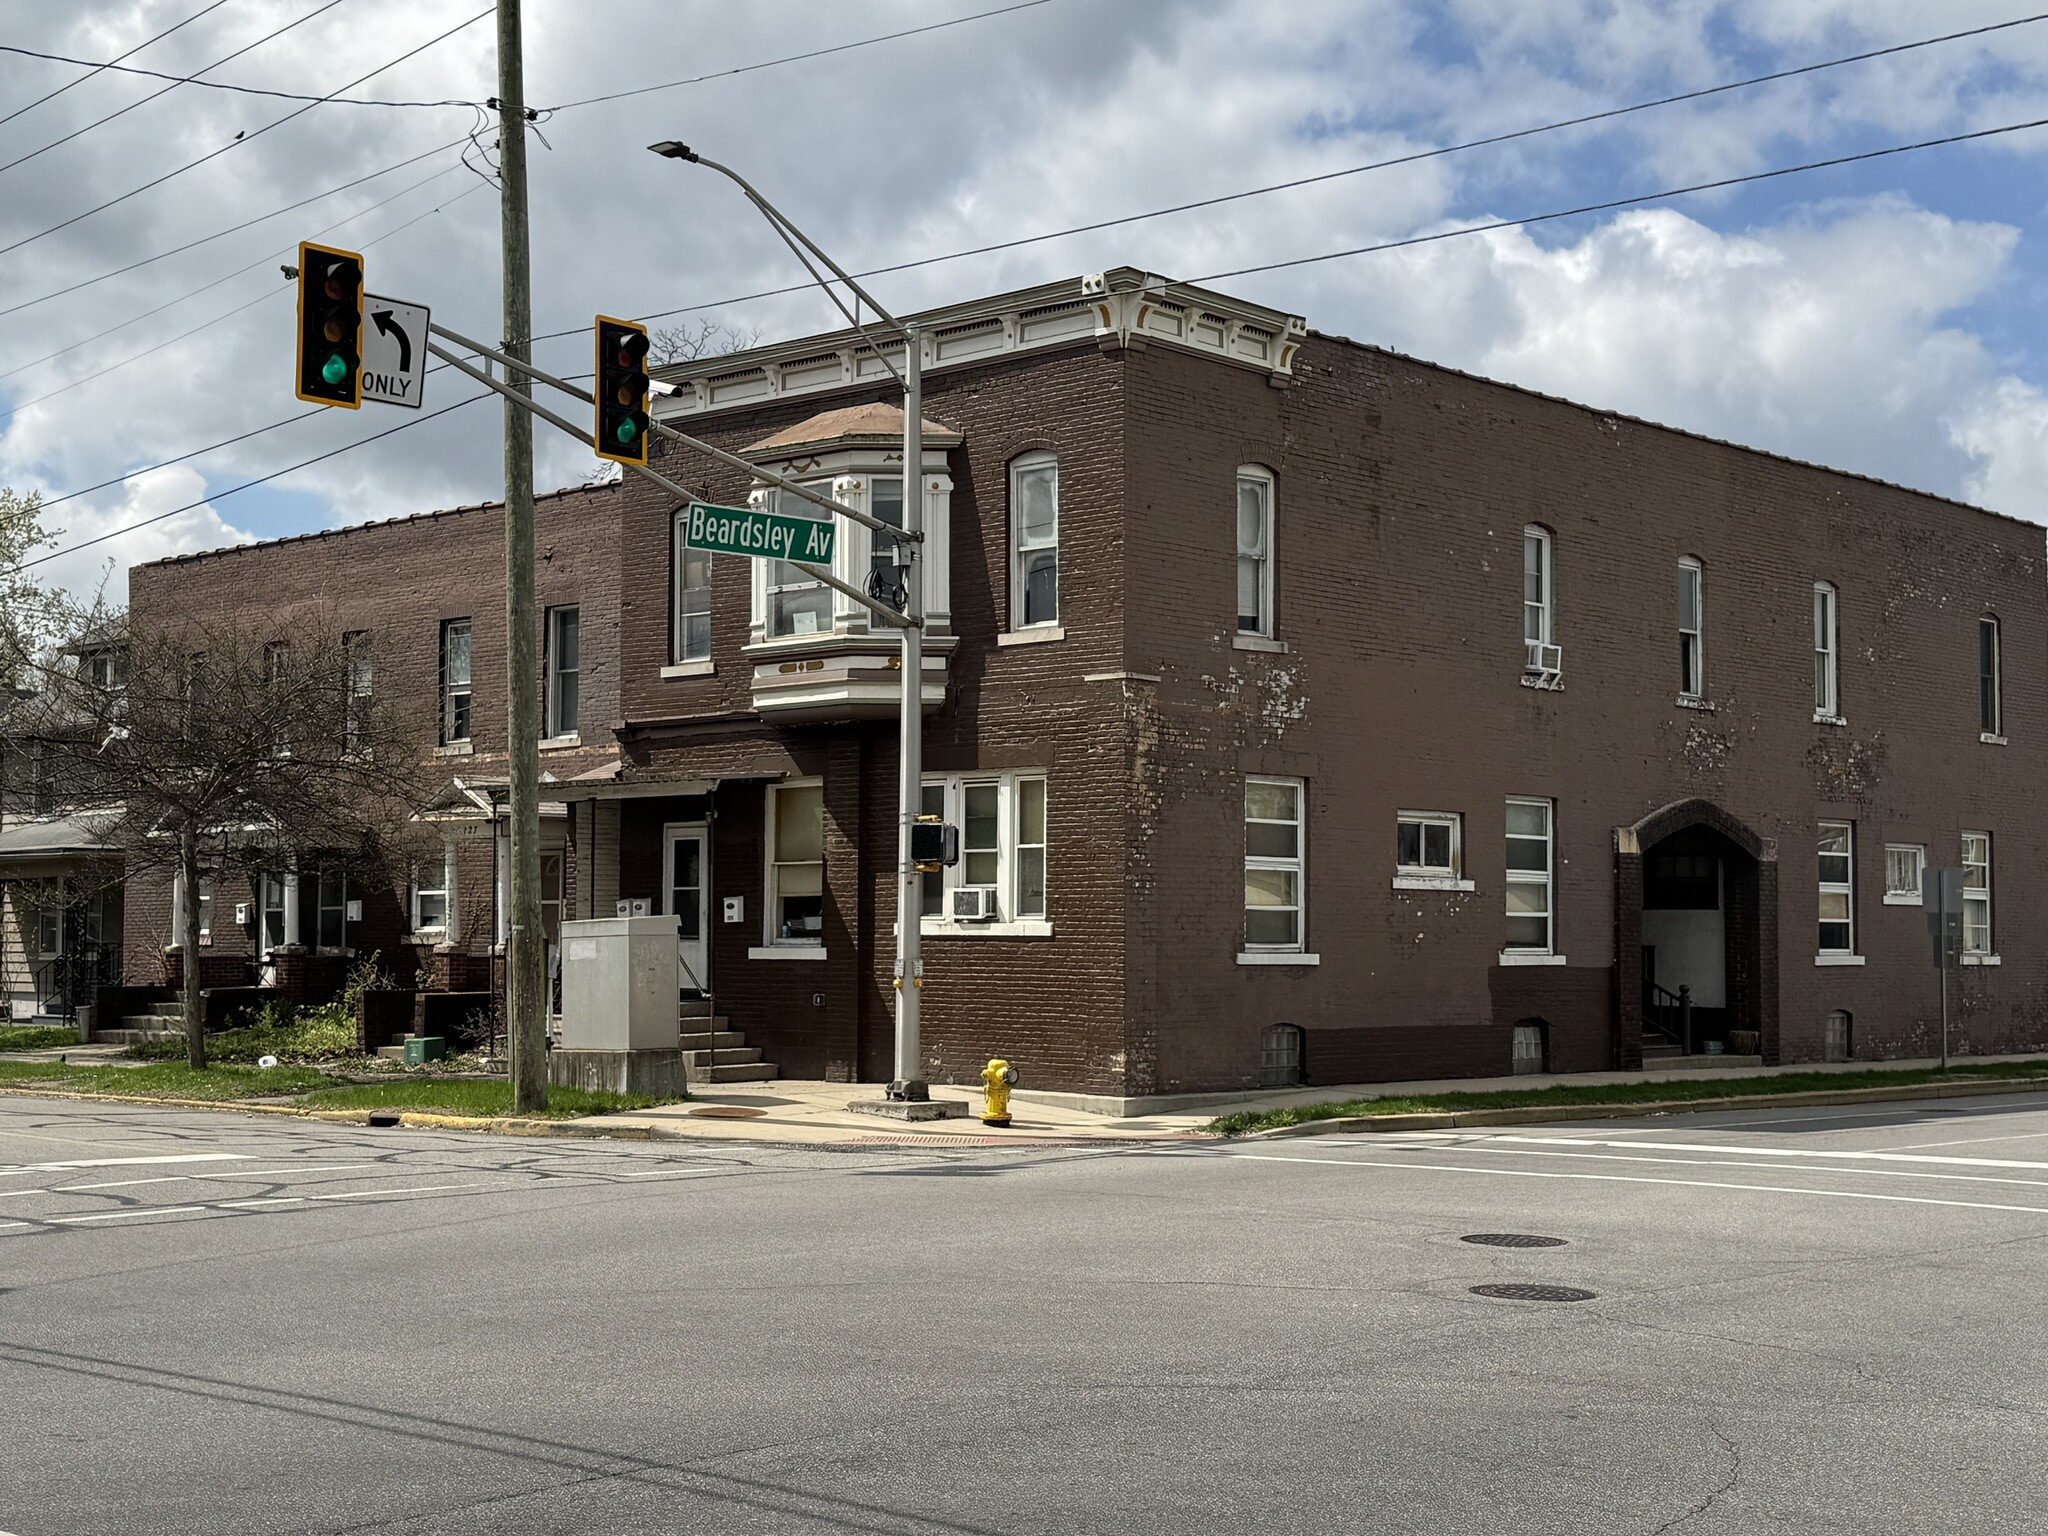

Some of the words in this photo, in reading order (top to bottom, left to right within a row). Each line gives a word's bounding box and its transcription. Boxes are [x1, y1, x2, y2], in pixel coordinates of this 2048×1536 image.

[362, 371, 411, 397] ONLY
[691, 507, 795, 559] Beardsley
[805, 523, 830, 556] Av
